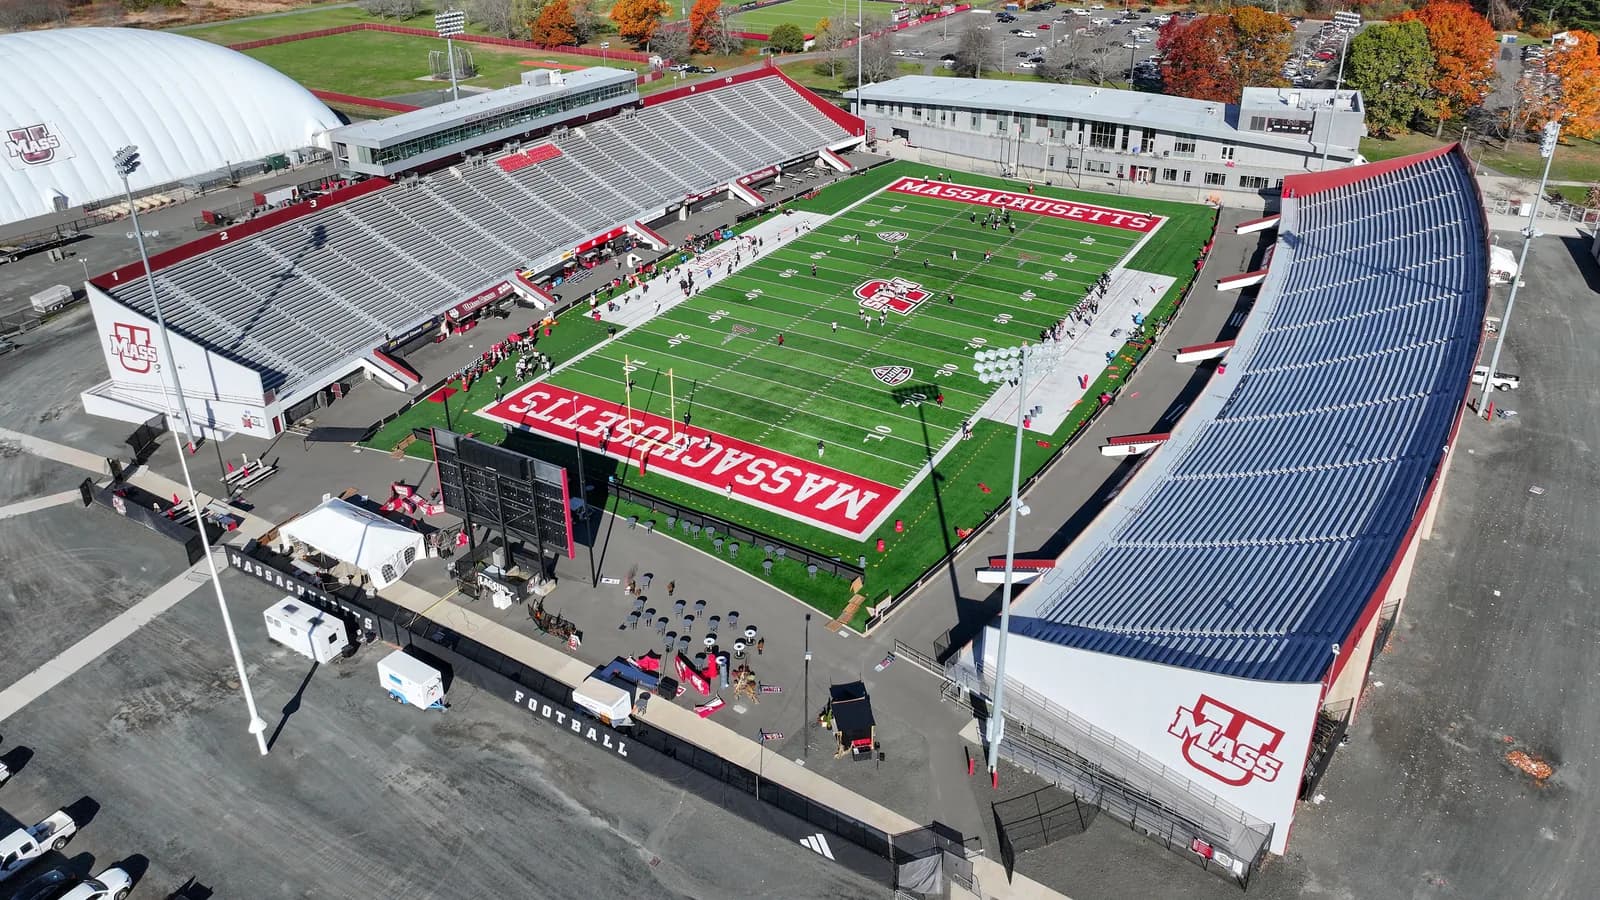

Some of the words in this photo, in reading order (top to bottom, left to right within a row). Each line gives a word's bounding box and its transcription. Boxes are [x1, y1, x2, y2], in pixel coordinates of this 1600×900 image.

[310, 200, 317, 208] 3
[896, 181, 1151, 229] MASSACHUSETTS
[219, 231, 229, 241] 2
[112, 271, 119, 281] 1
[867, 425, 892, 441] 10
[508, 391, 881, 520] MASSACHUSETTS
[231, 553, 373, 630] MASSACHUSETTS
[514, 690, 627, 757] FOOTBALL
